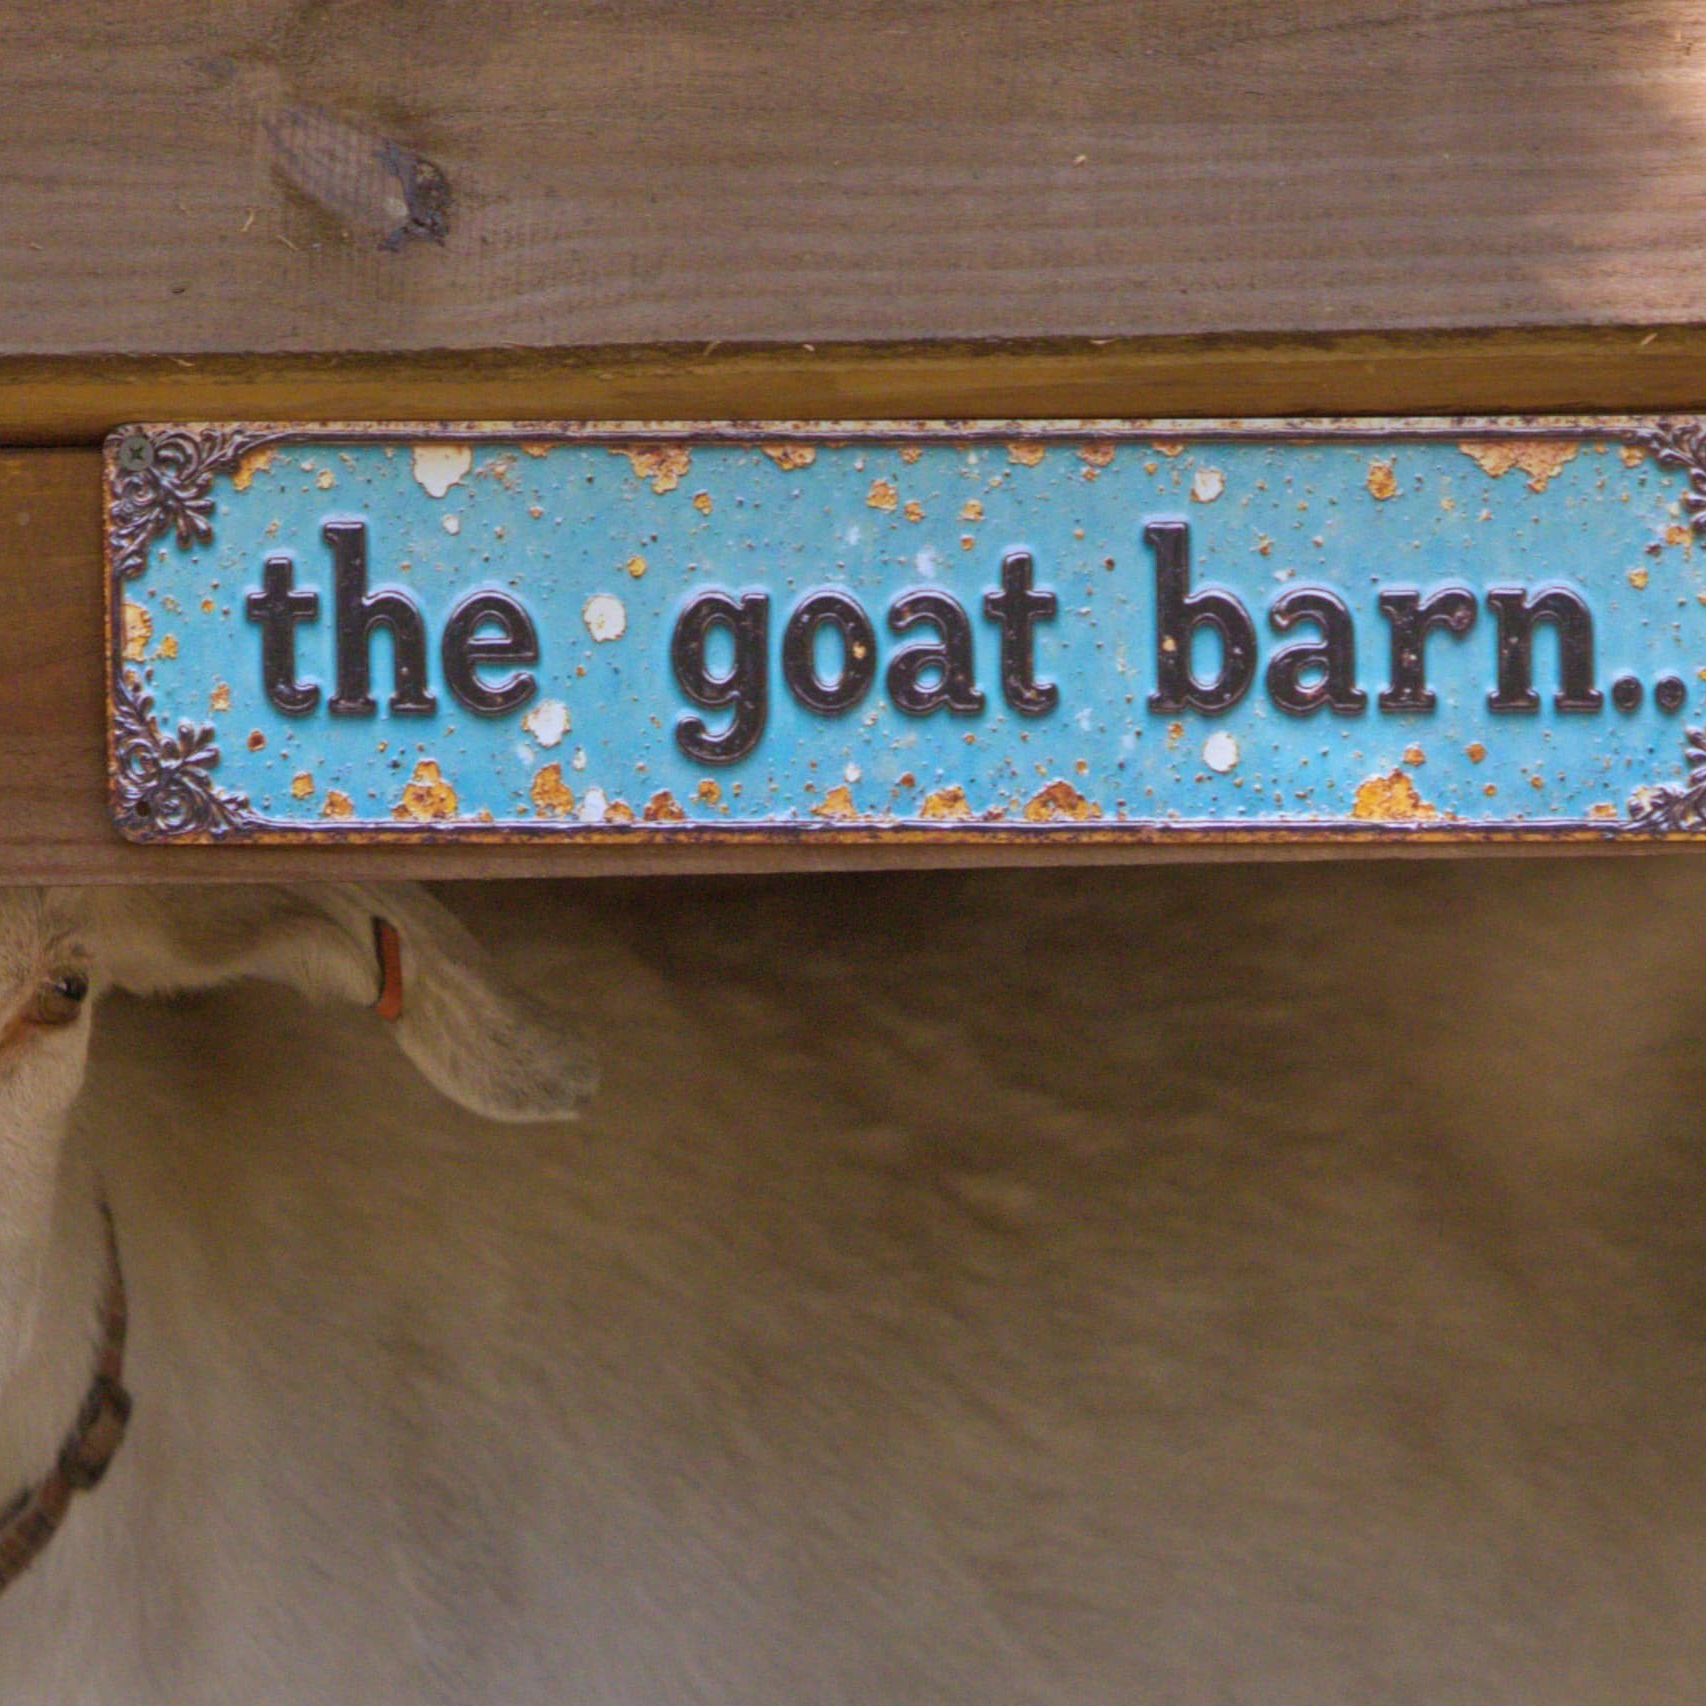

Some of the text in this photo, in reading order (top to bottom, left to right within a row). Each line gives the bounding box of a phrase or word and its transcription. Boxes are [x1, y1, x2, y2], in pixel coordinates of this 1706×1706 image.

[247, 520, 1688, 763] the goat barn..
